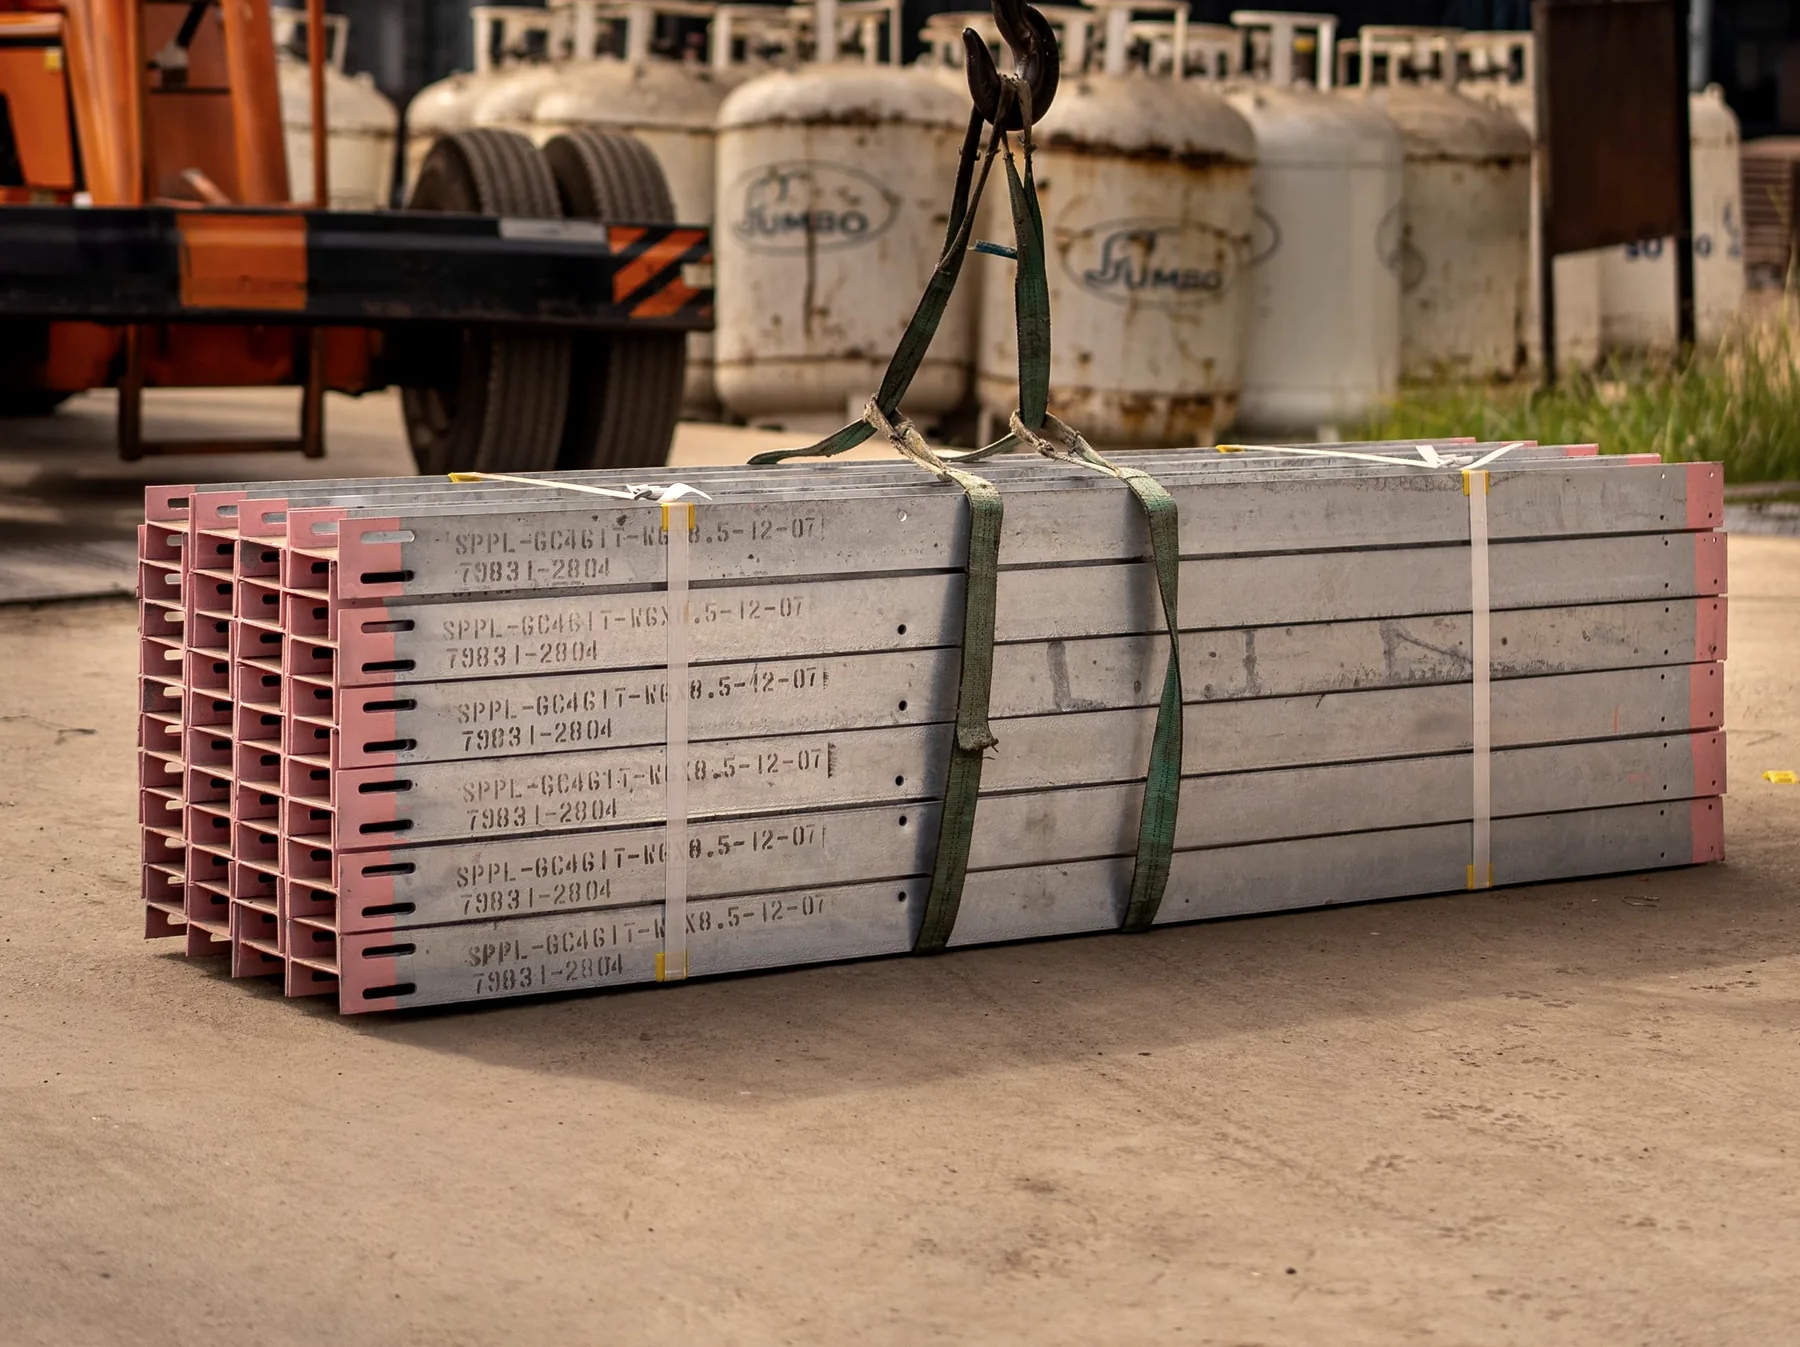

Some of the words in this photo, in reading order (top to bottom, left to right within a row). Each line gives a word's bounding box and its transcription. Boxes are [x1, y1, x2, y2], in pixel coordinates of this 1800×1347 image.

[1084, 227, 1222, 290] JUMBO
[459, 557, 610, 583] 79831-2804
[446, 639, 597, 669] 79831-2804
[462, 718, 612, 751] 79831-2804
[467, 798, 617, 830] 79831-2804
[461, 879, 611, 915] 79831-2804
[473, 953, 622, 994] 79831-2804
